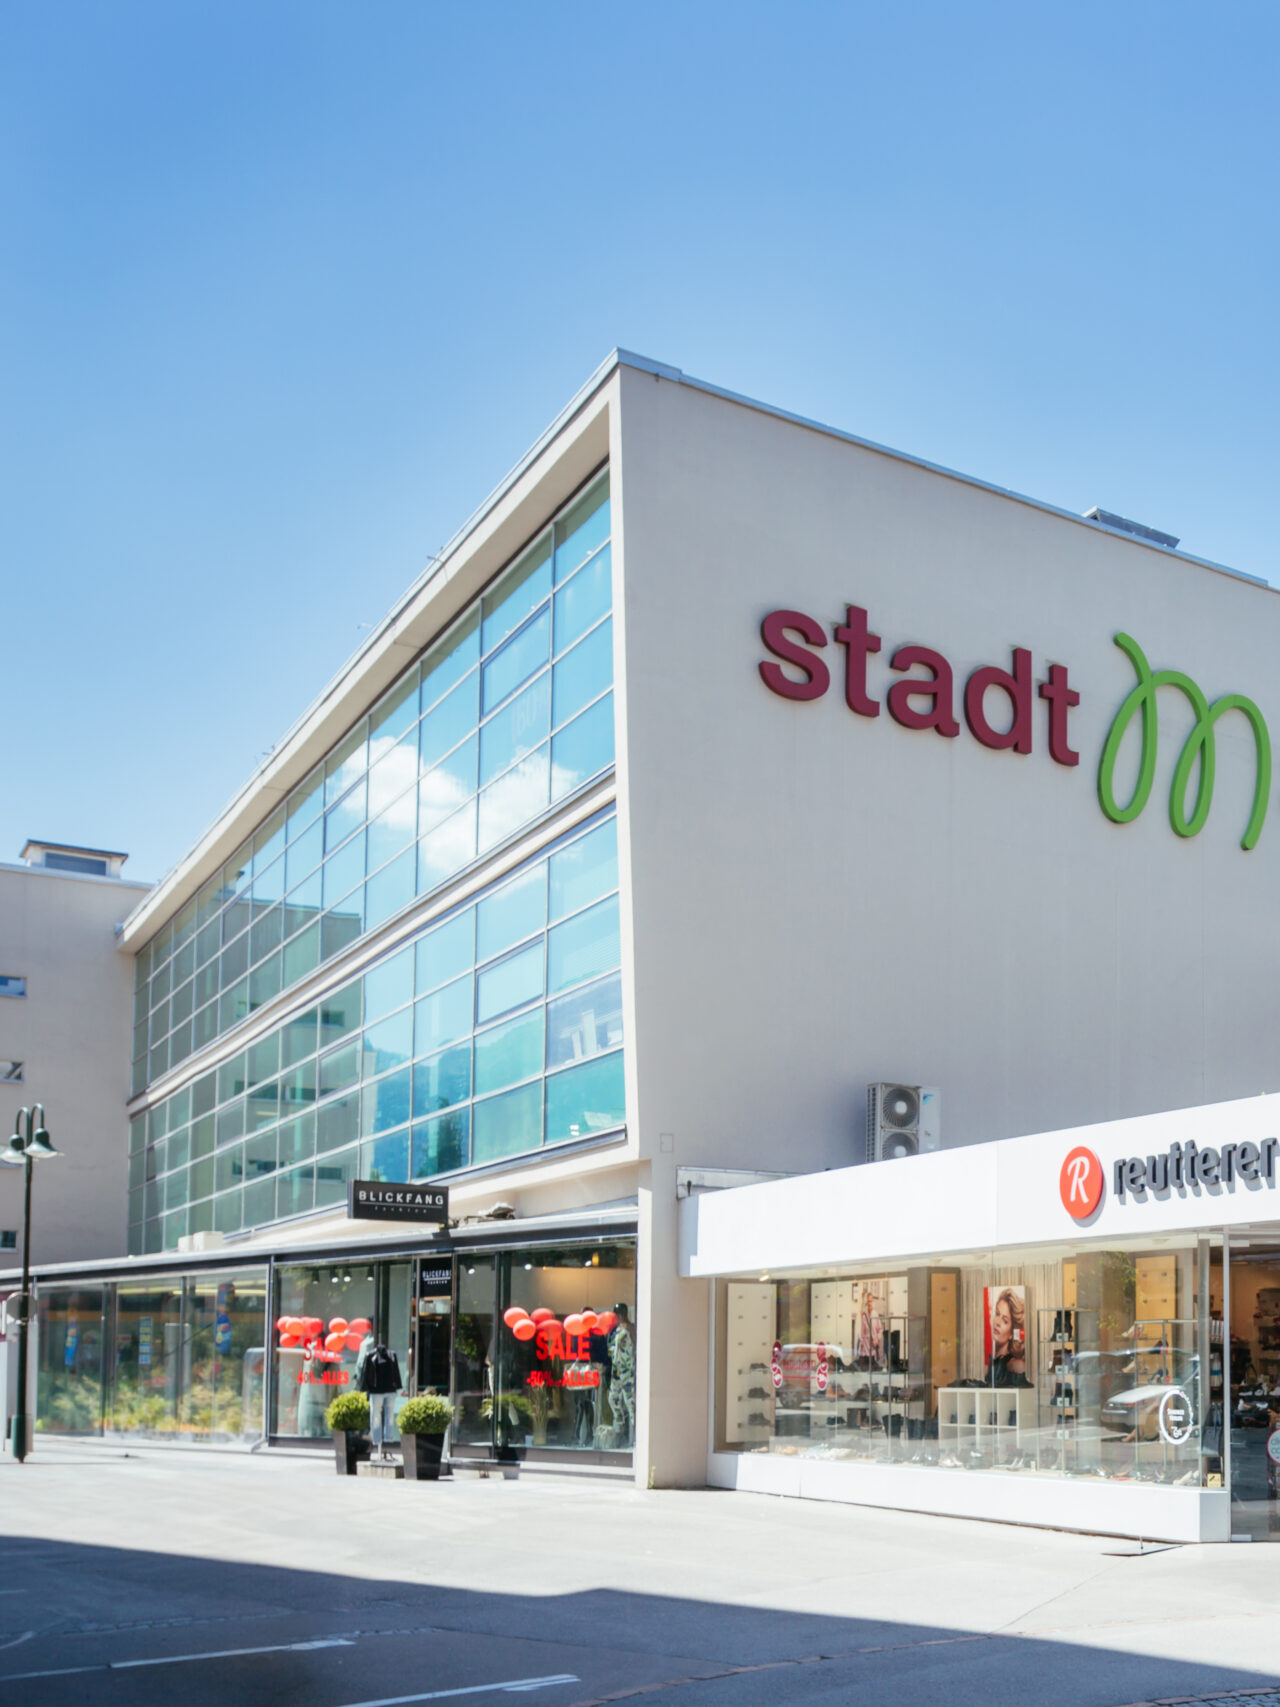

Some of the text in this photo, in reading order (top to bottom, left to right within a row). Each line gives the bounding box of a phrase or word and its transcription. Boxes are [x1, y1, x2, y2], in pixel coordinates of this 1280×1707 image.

[1113, 1137, 1280, 1197] reutterer
[358, 1190, 445, 1206] BLICKFANG
[535, 1328, 591, 1361] SALE
[561, 1369, 600, 1388] ALLES
